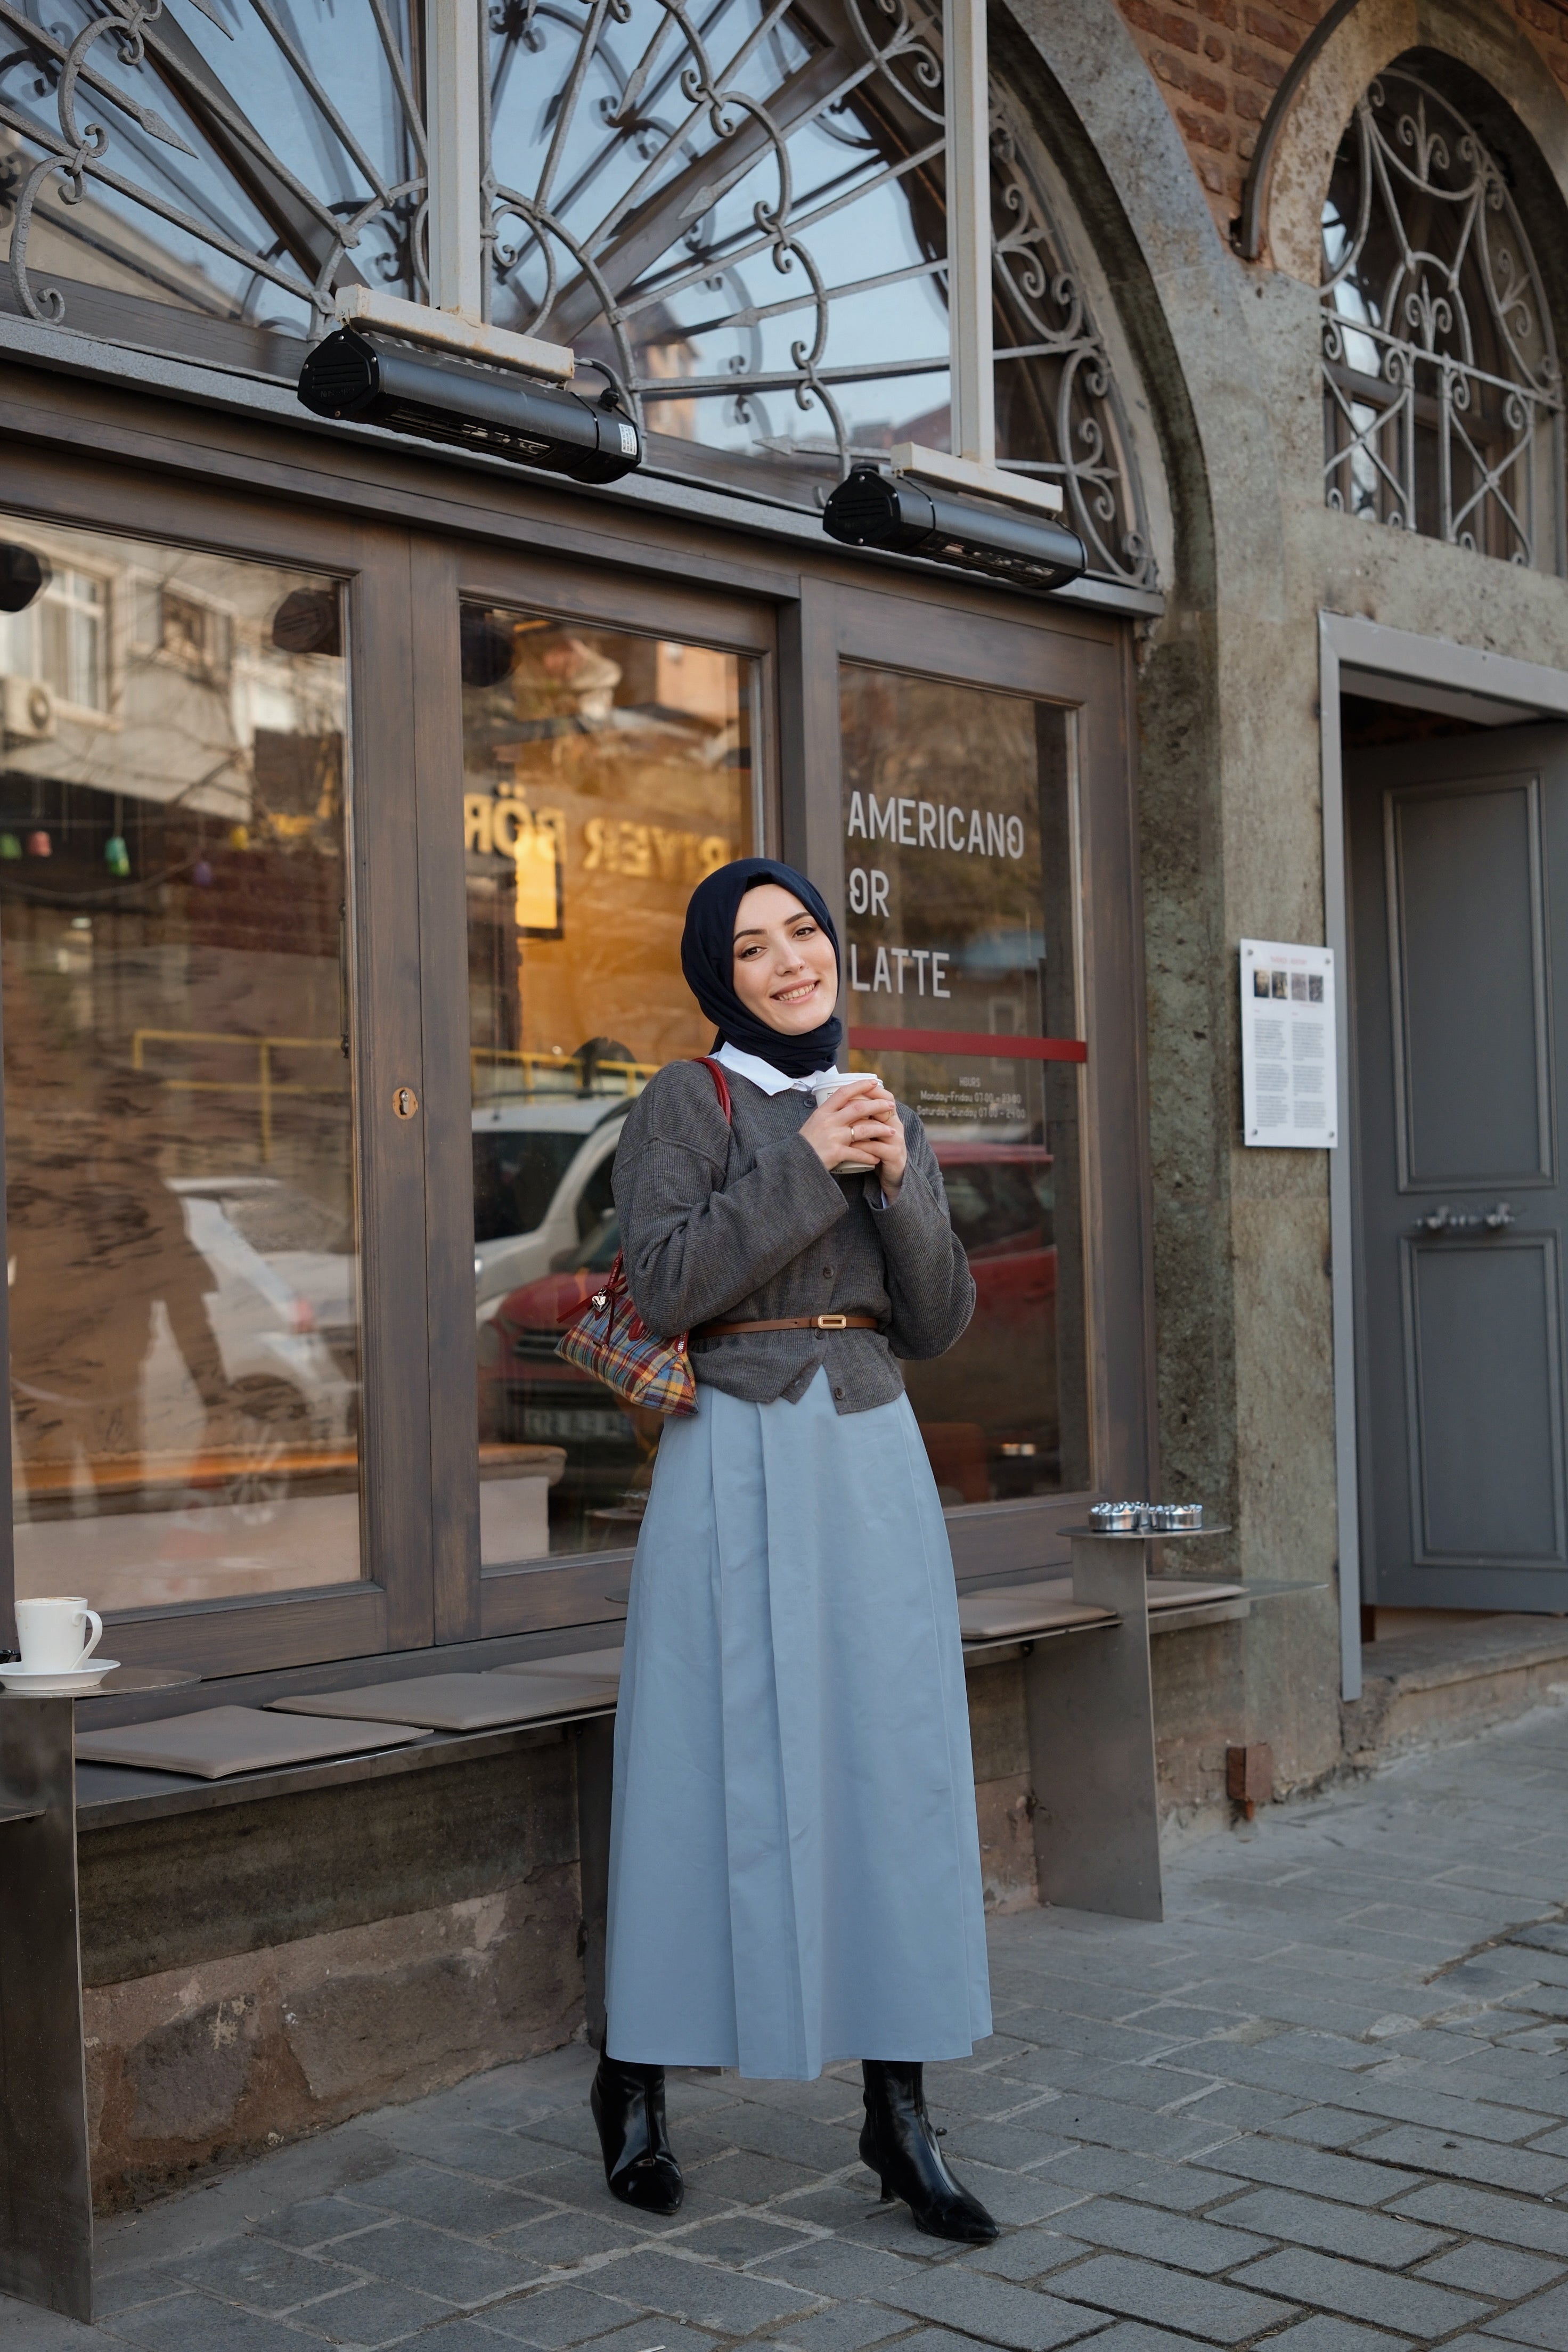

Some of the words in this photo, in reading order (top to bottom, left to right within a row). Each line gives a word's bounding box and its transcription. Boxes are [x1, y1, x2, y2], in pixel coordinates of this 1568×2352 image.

[848, 791, 1024, 859] AMERICANO
[850, 868, 889, 917] OR
[851, 943, 951, 998] LATTE
[959, 1076, 981, 1088] HOURS
